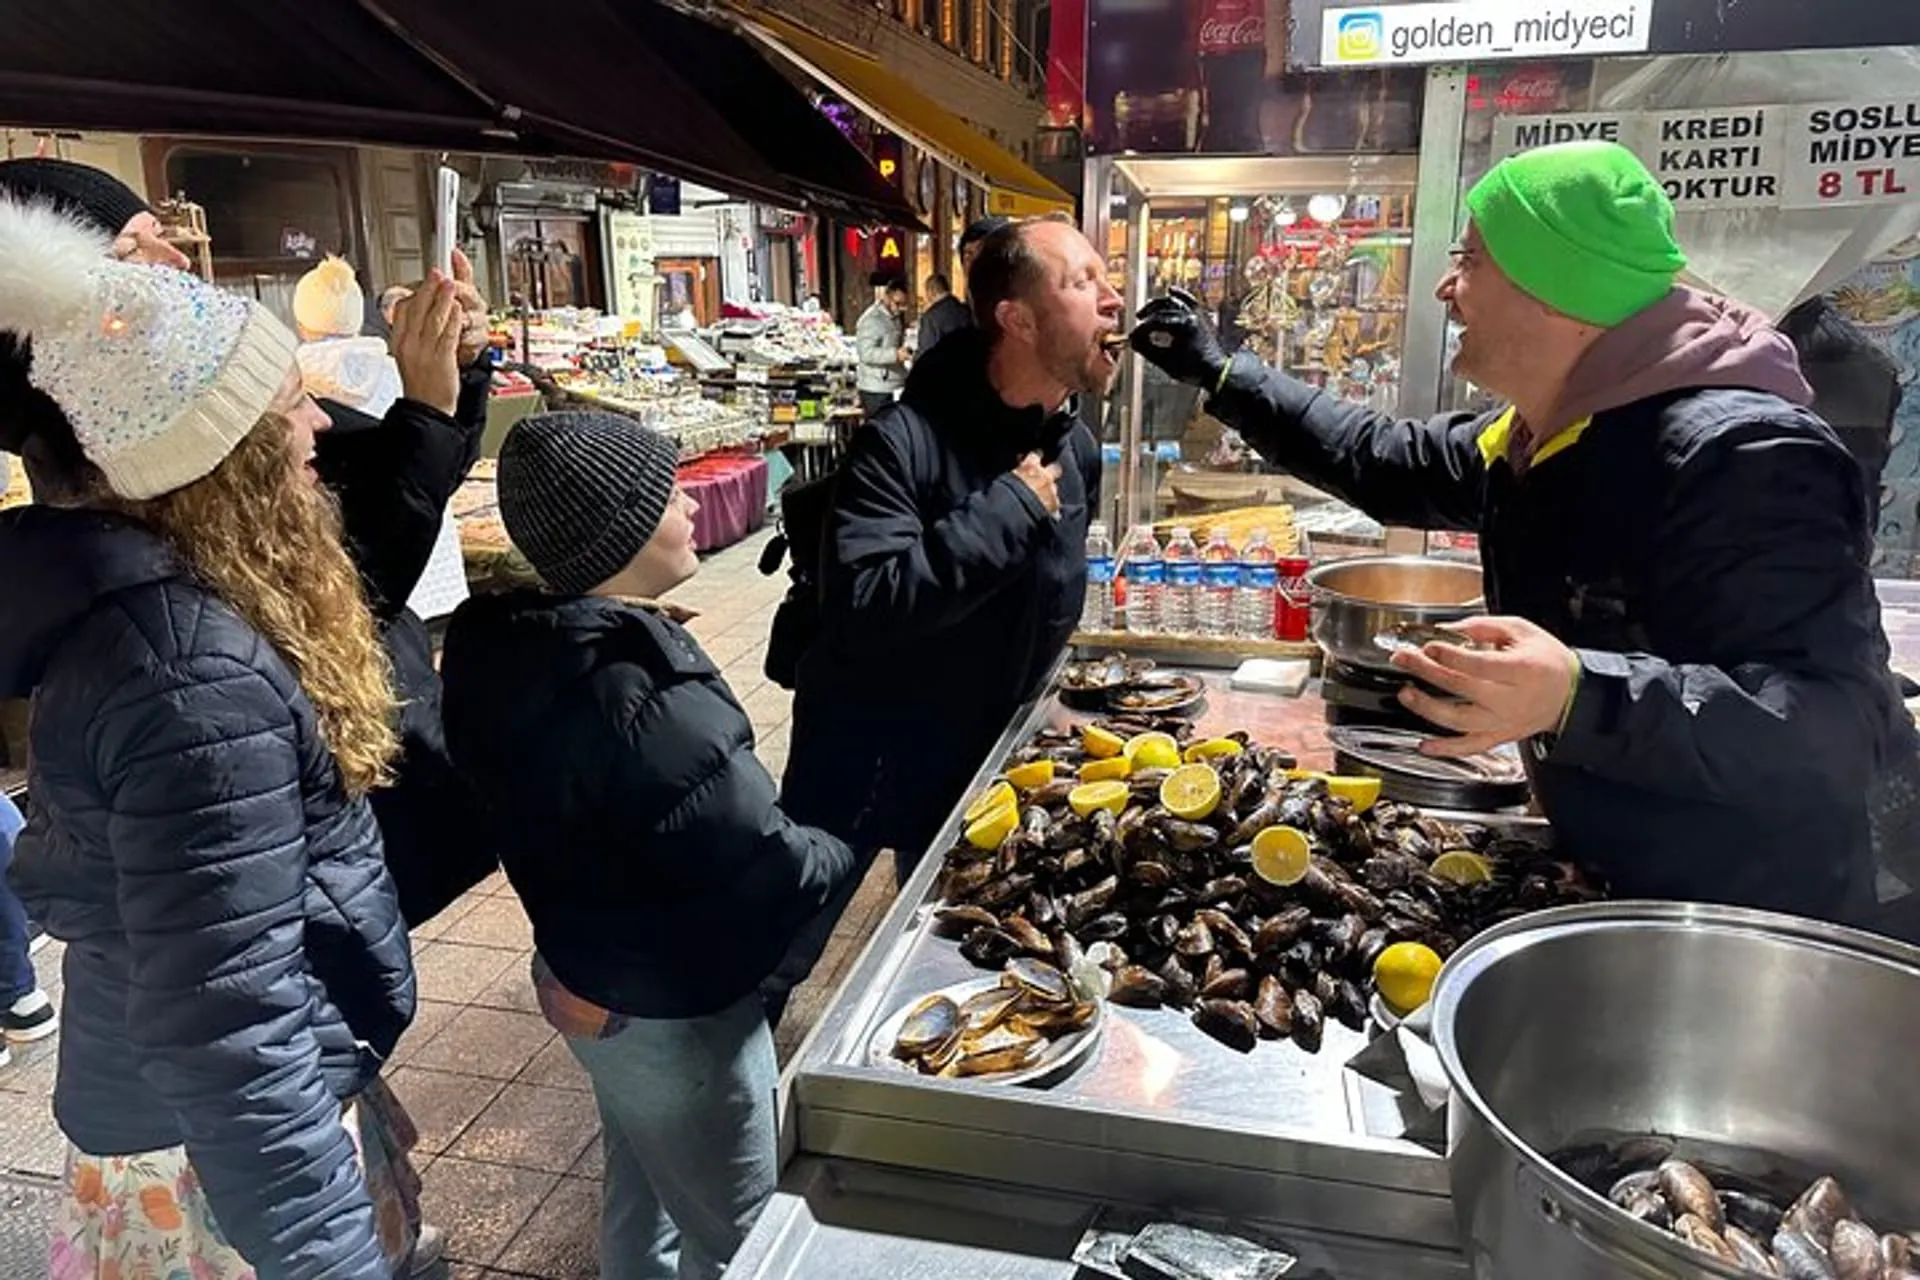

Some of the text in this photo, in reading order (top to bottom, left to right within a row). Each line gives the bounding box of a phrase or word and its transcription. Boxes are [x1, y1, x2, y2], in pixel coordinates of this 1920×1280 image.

[1391, 6, 1636, 57] golden_midyeci
[1515, 119, 1619, 146] MİDYE
[1662, 110, 1763, 141] KREDİ
[1809, 104, 1920, 134] SOSLU
[1660, 146, 1760, 171] KARTI
[1810, 133, 1920, 164] MİDYE
[1662, 176, 1776, 200] OKTUR
[1818, 167, 1906, 198] 8 TL
